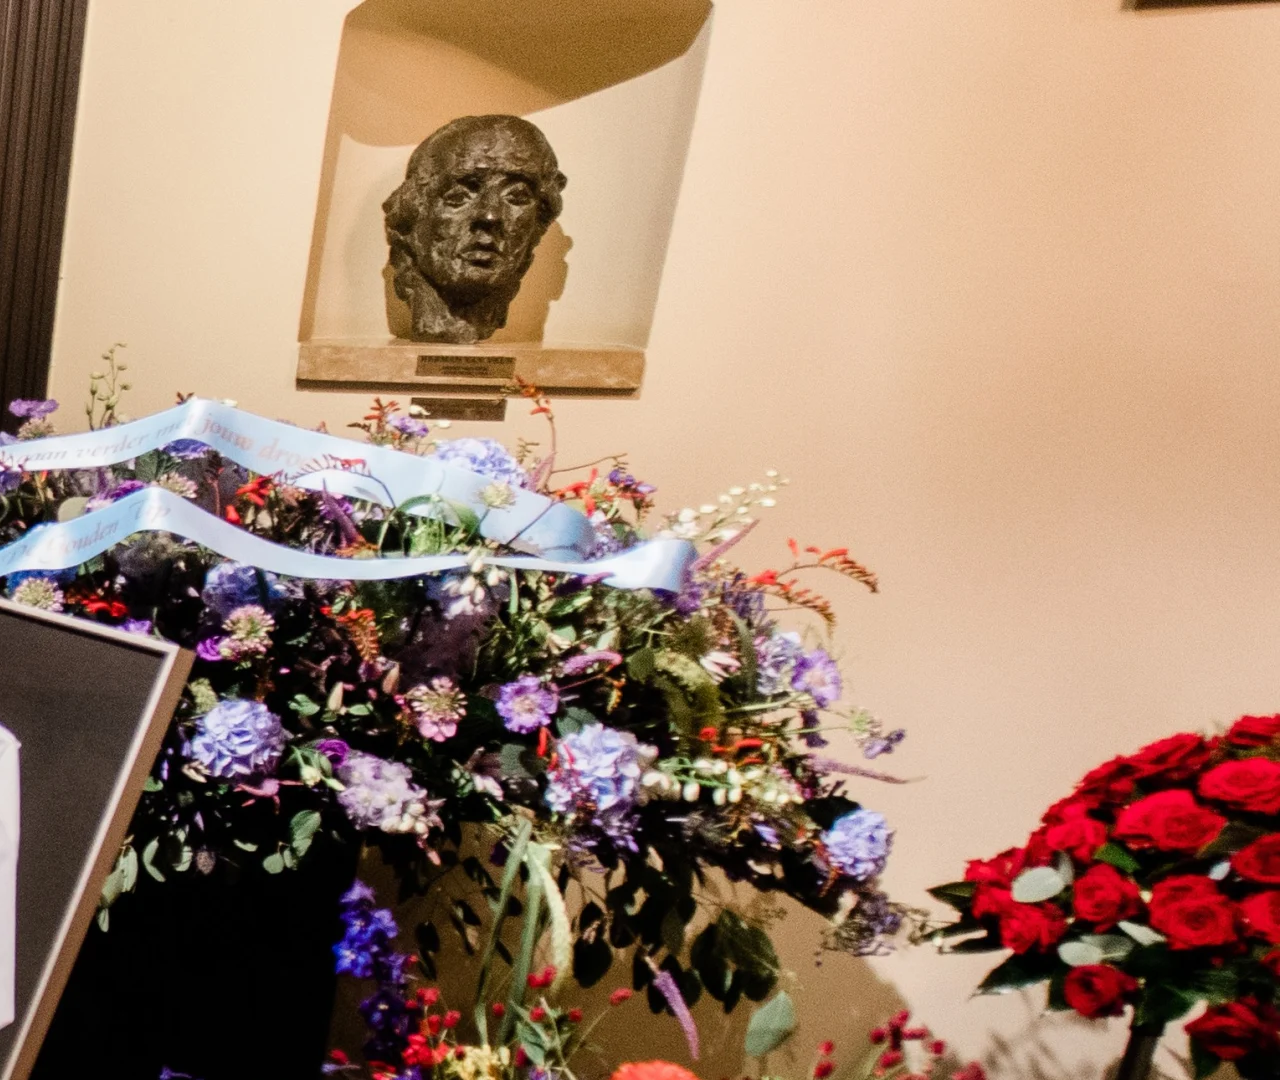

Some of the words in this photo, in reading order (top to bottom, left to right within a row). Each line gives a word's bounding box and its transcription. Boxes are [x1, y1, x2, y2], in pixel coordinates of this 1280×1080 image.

[76, 432, 150, 458] verder
[194, 412, 256, 452] jouw
[37, 518, 120, 564] Gouden
